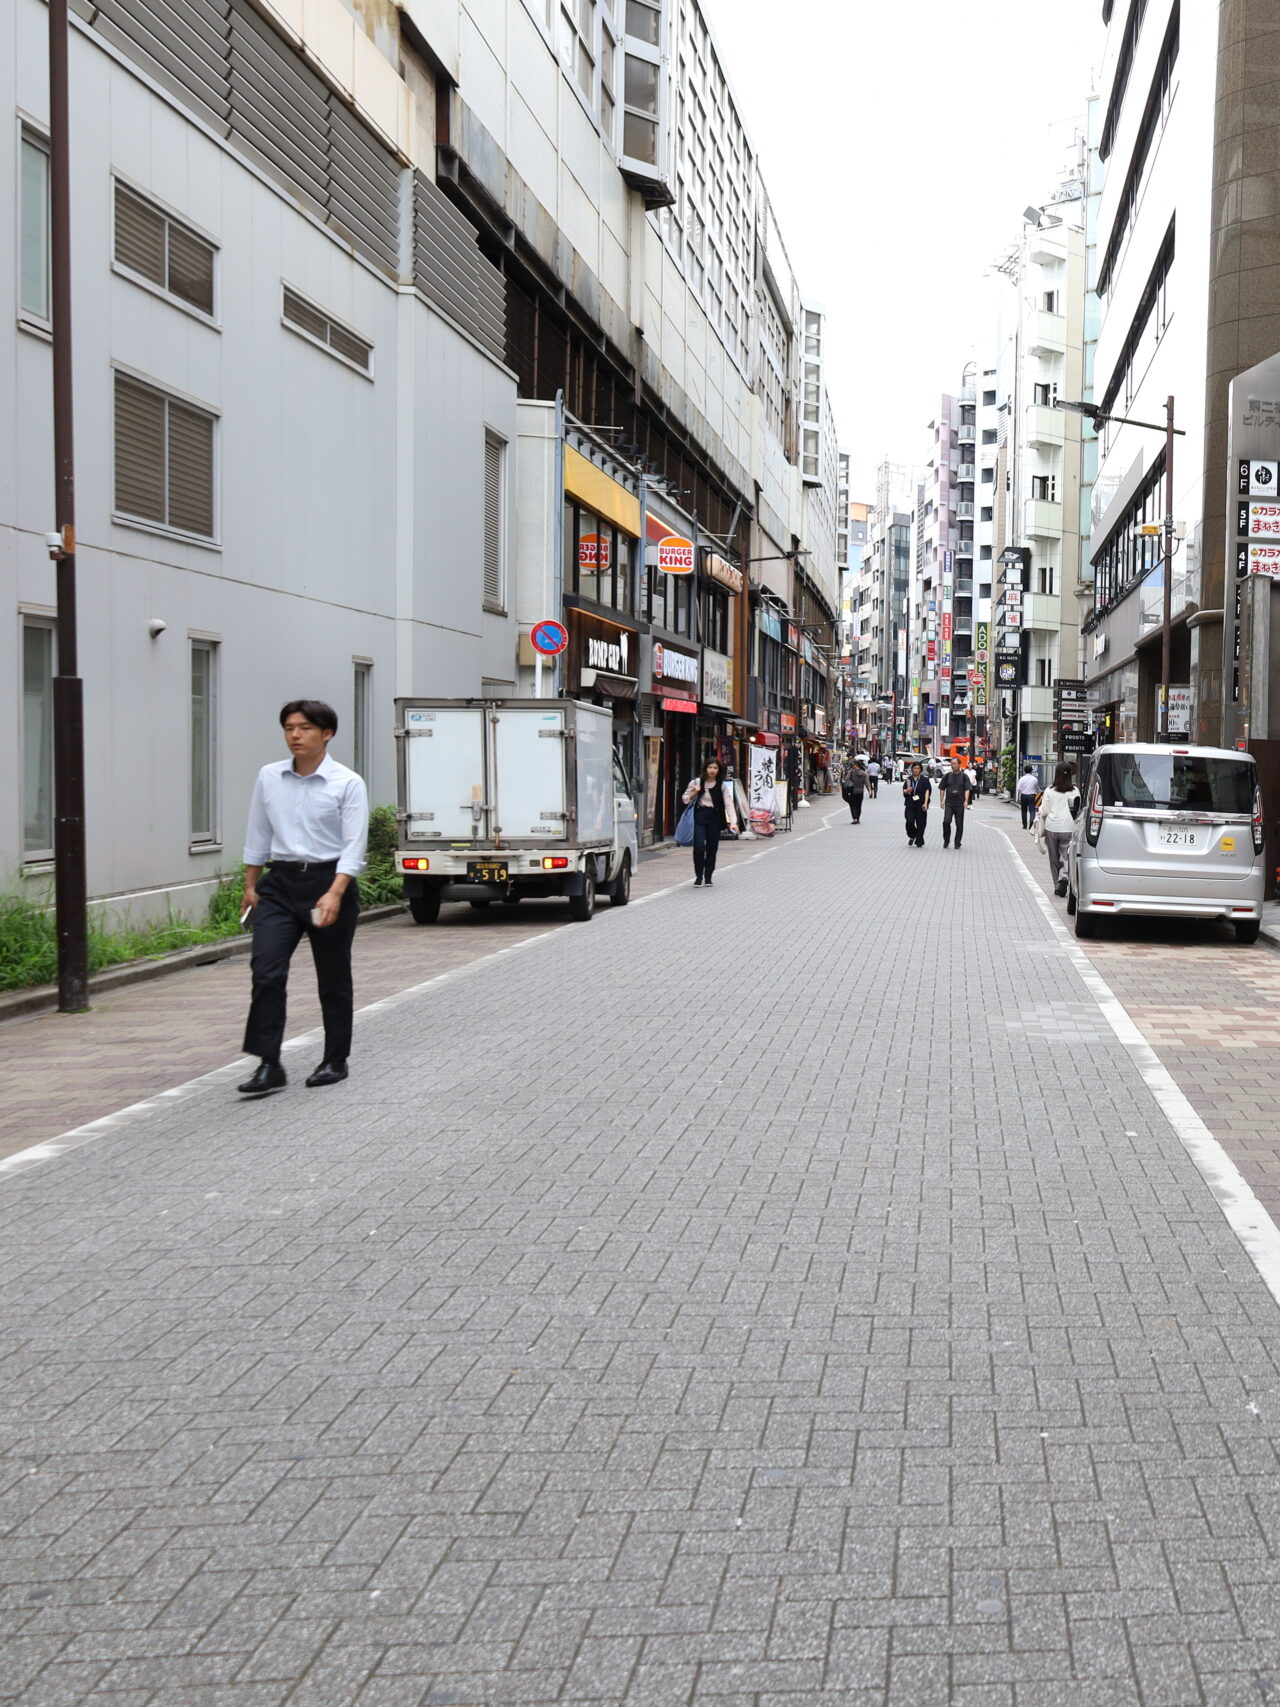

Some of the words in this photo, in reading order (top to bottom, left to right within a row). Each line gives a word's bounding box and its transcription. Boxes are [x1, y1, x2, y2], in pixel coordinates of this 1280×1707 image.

[659, 547, 693, 556] BURGER
[659, 556, 693, 567] KING
[1166, 832, 1196, 845] 22-18
